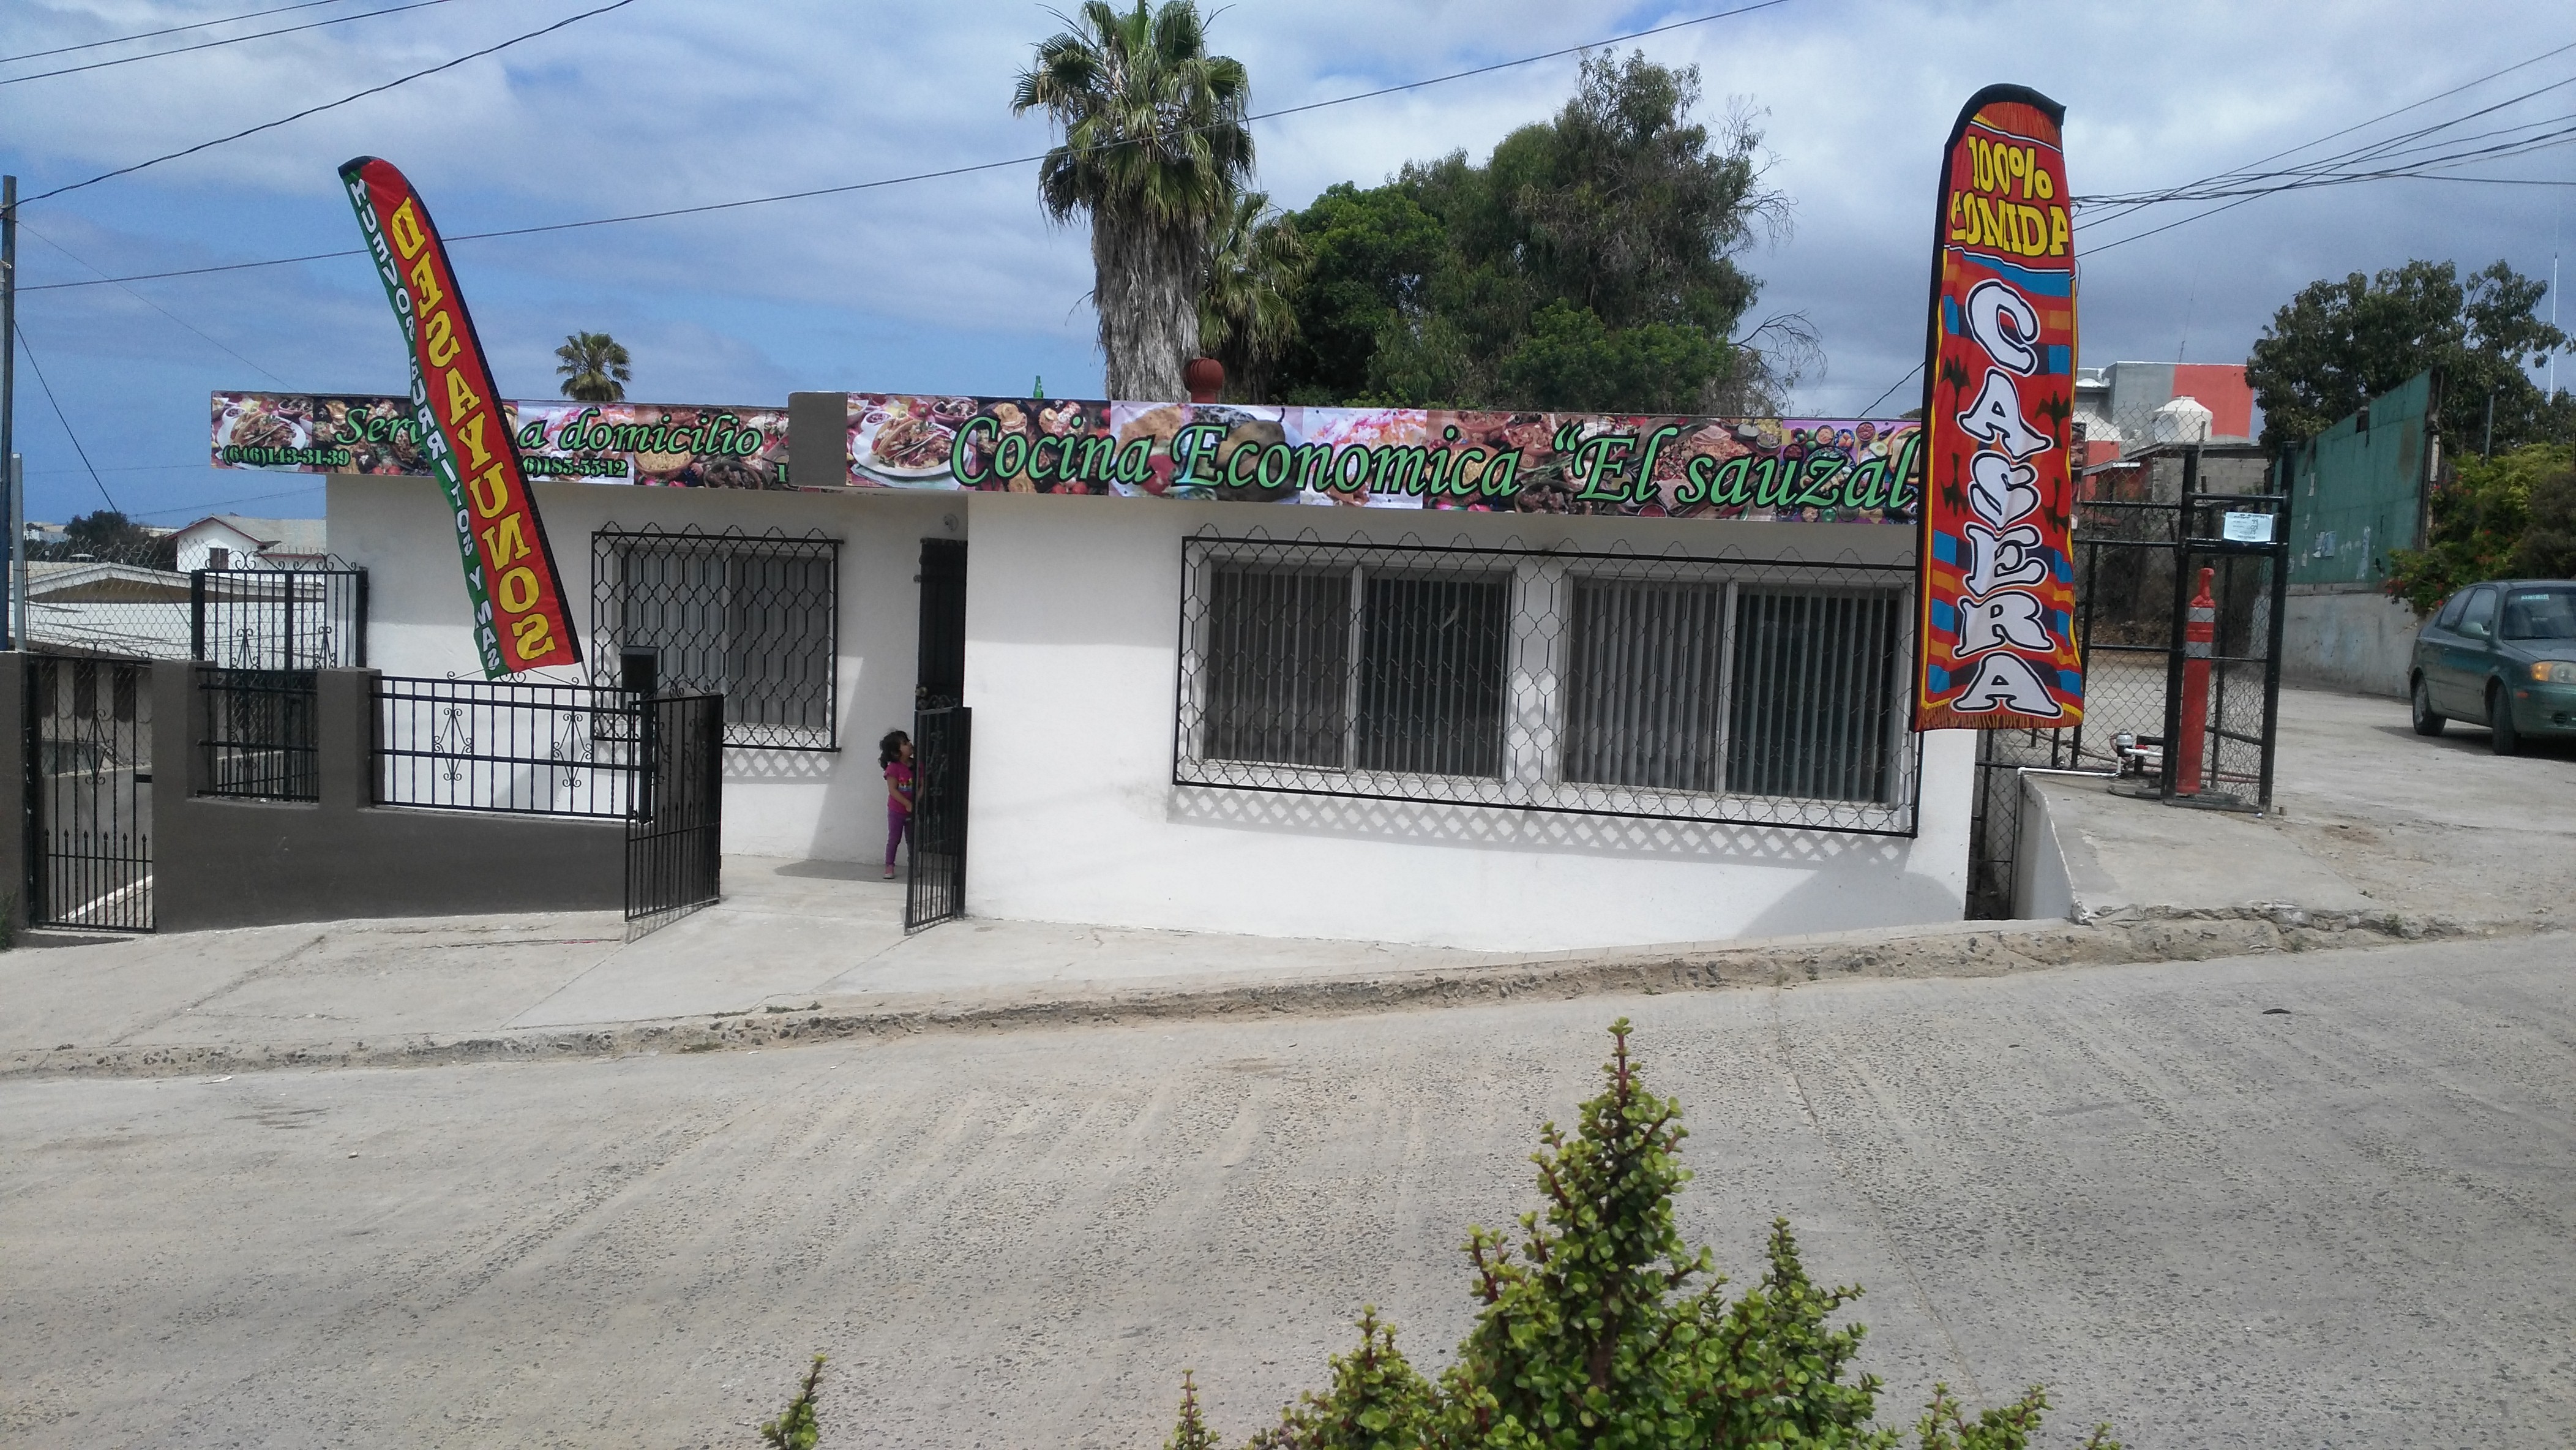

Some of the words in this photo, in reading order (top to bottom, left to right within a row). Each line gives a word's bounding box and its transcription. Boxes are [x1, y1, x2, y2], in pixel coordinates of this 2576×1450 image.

[1967, 135, 2054, 201] 100%
[519, 418, 550, 450] a
[558, 407, 763, 456] domicilio
[949, 415, 1156, 486] Cocina
[1172, 420, 1524, 497] Economica
[523, 456, 629, 478] 6)185-55-12
[1950, 278, 2064, 718] CASERA
